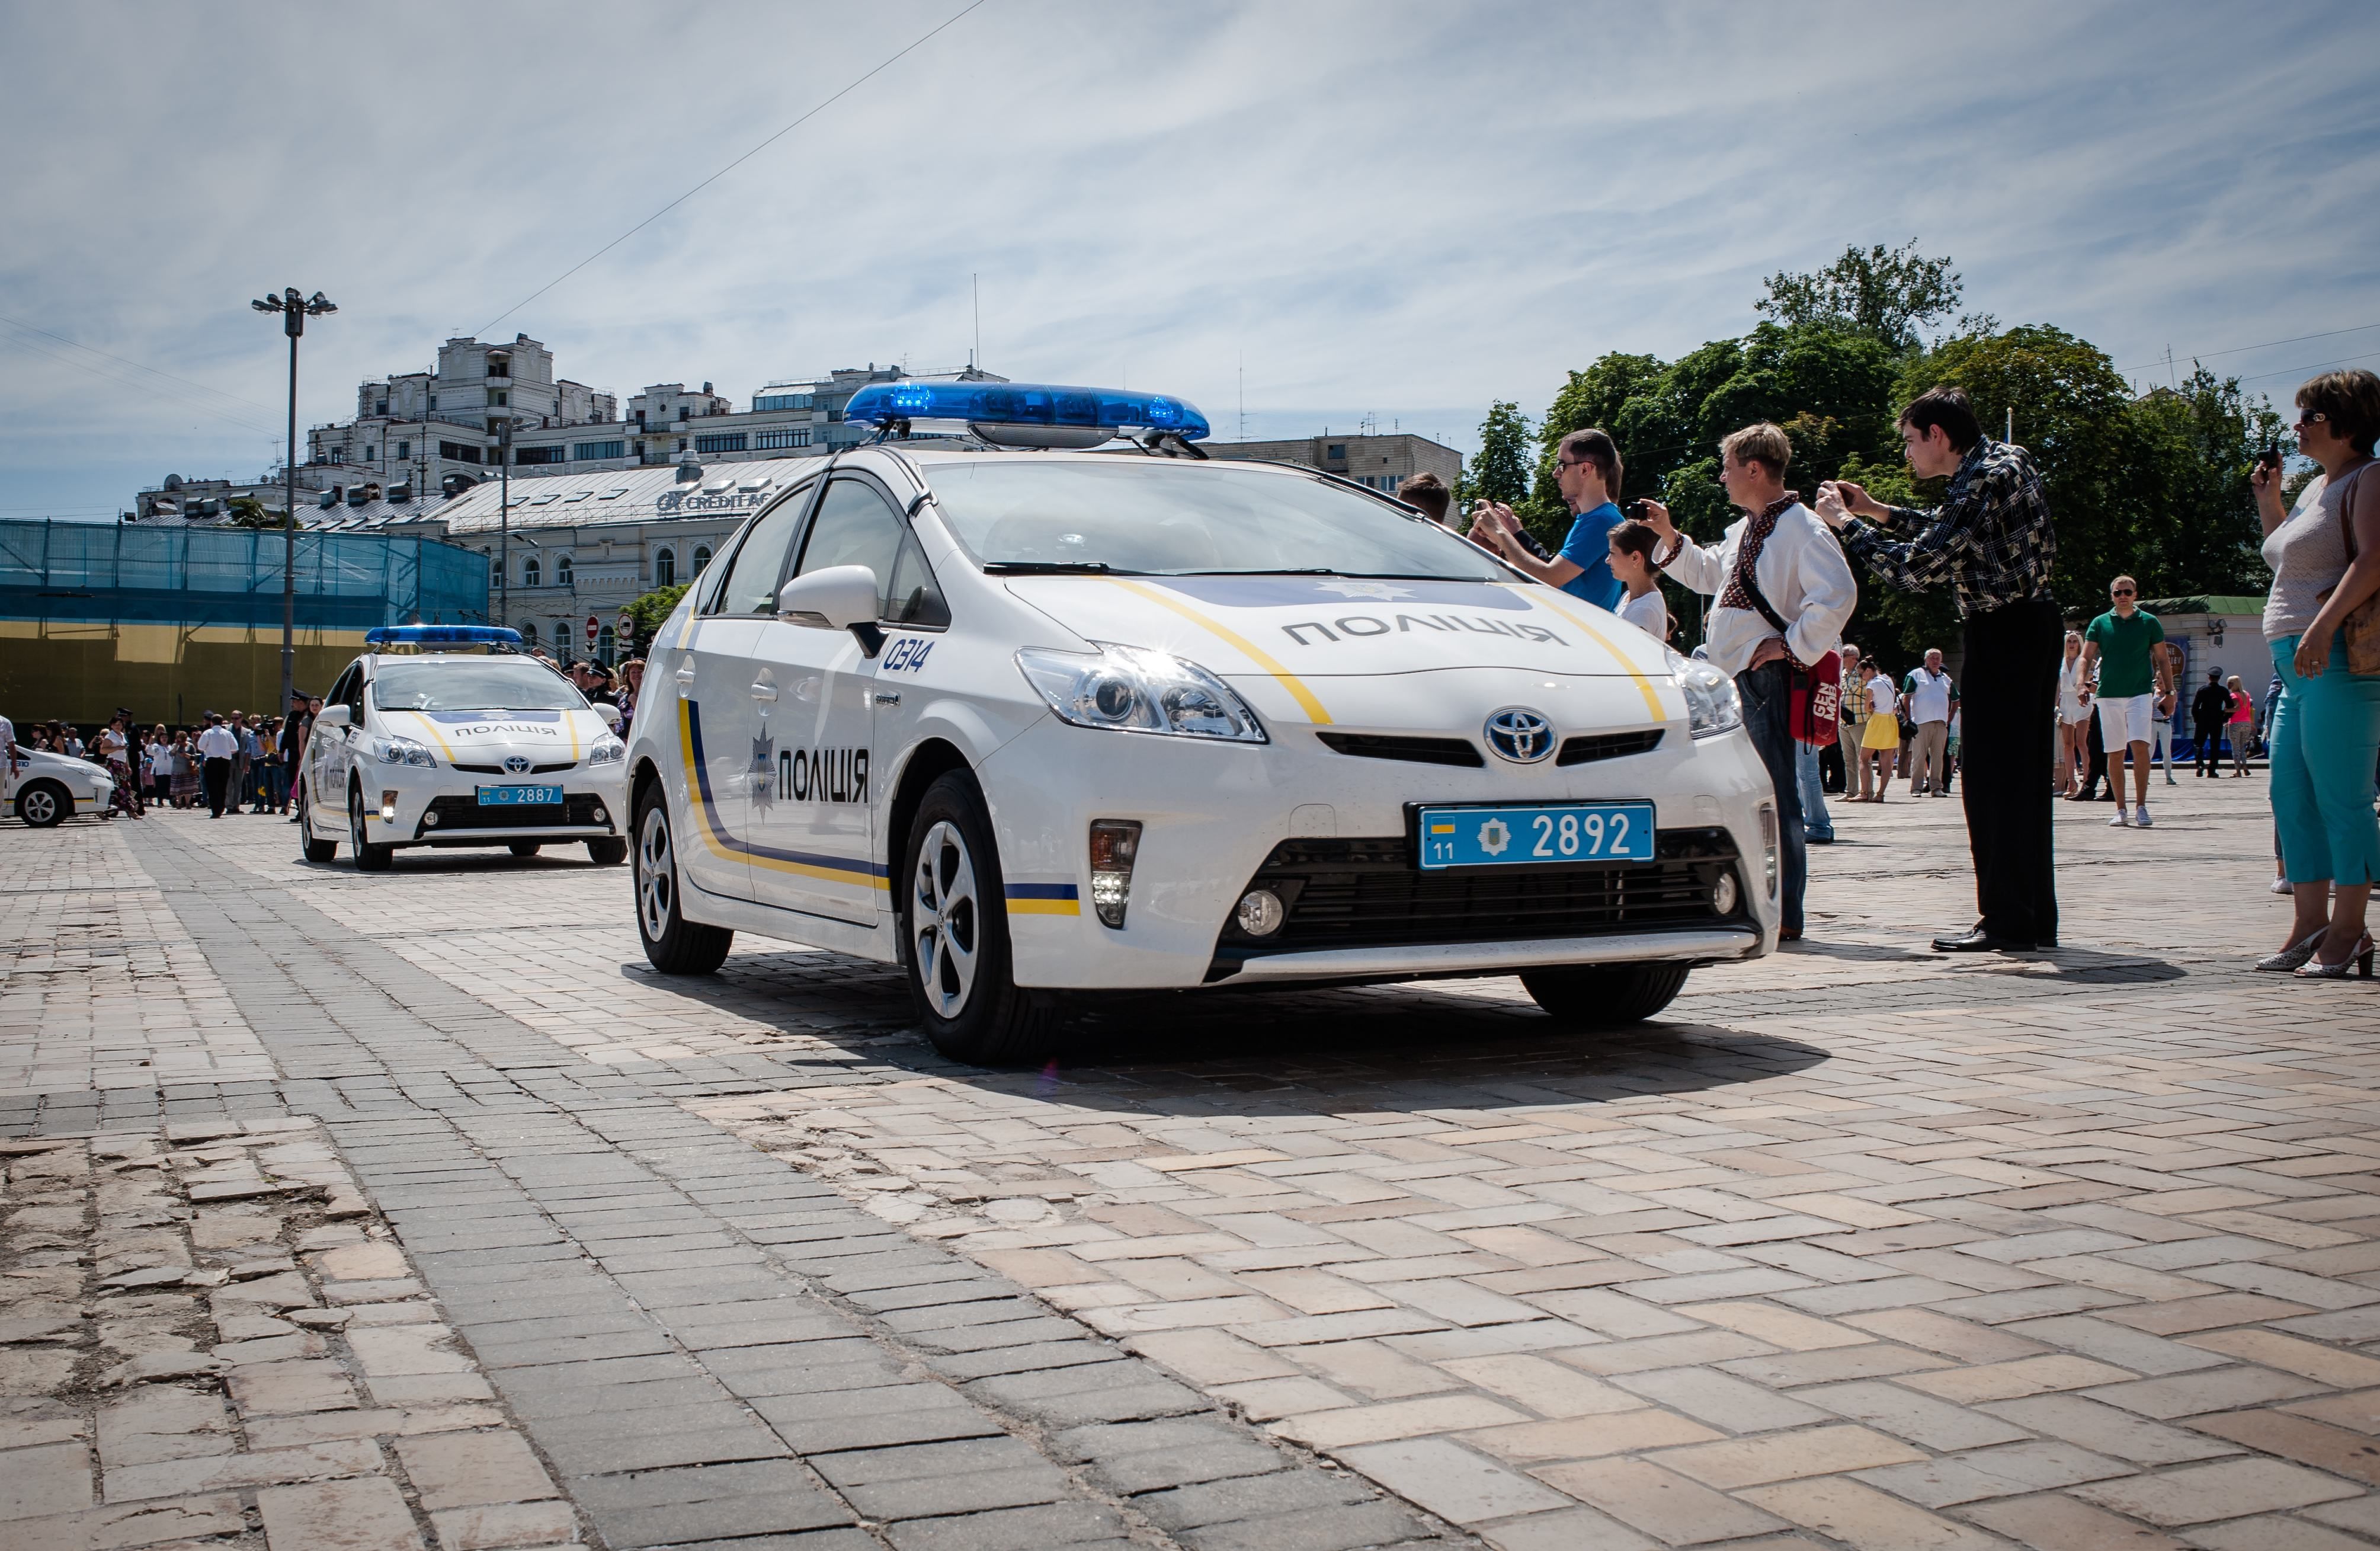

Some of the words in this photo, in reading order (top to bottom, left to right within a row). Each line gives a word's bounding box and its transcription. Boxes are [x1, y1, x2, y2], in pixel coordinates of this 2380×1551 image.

[1281, 614, 1570, 646] ПОЛІЦІЯ
[883, 639, 935, 672] 0314
[1813, 682, 1829, 717] GEN
[455, 725, 558, 736] ПОЛІЦІЯ
[779, 749, 869, 803] ПОЛІЦІЯ
[517, 788, 553, 802] 2887
[1433, 842, 1453, 859] 11
[1532, 813, 1631, 856] 2892
